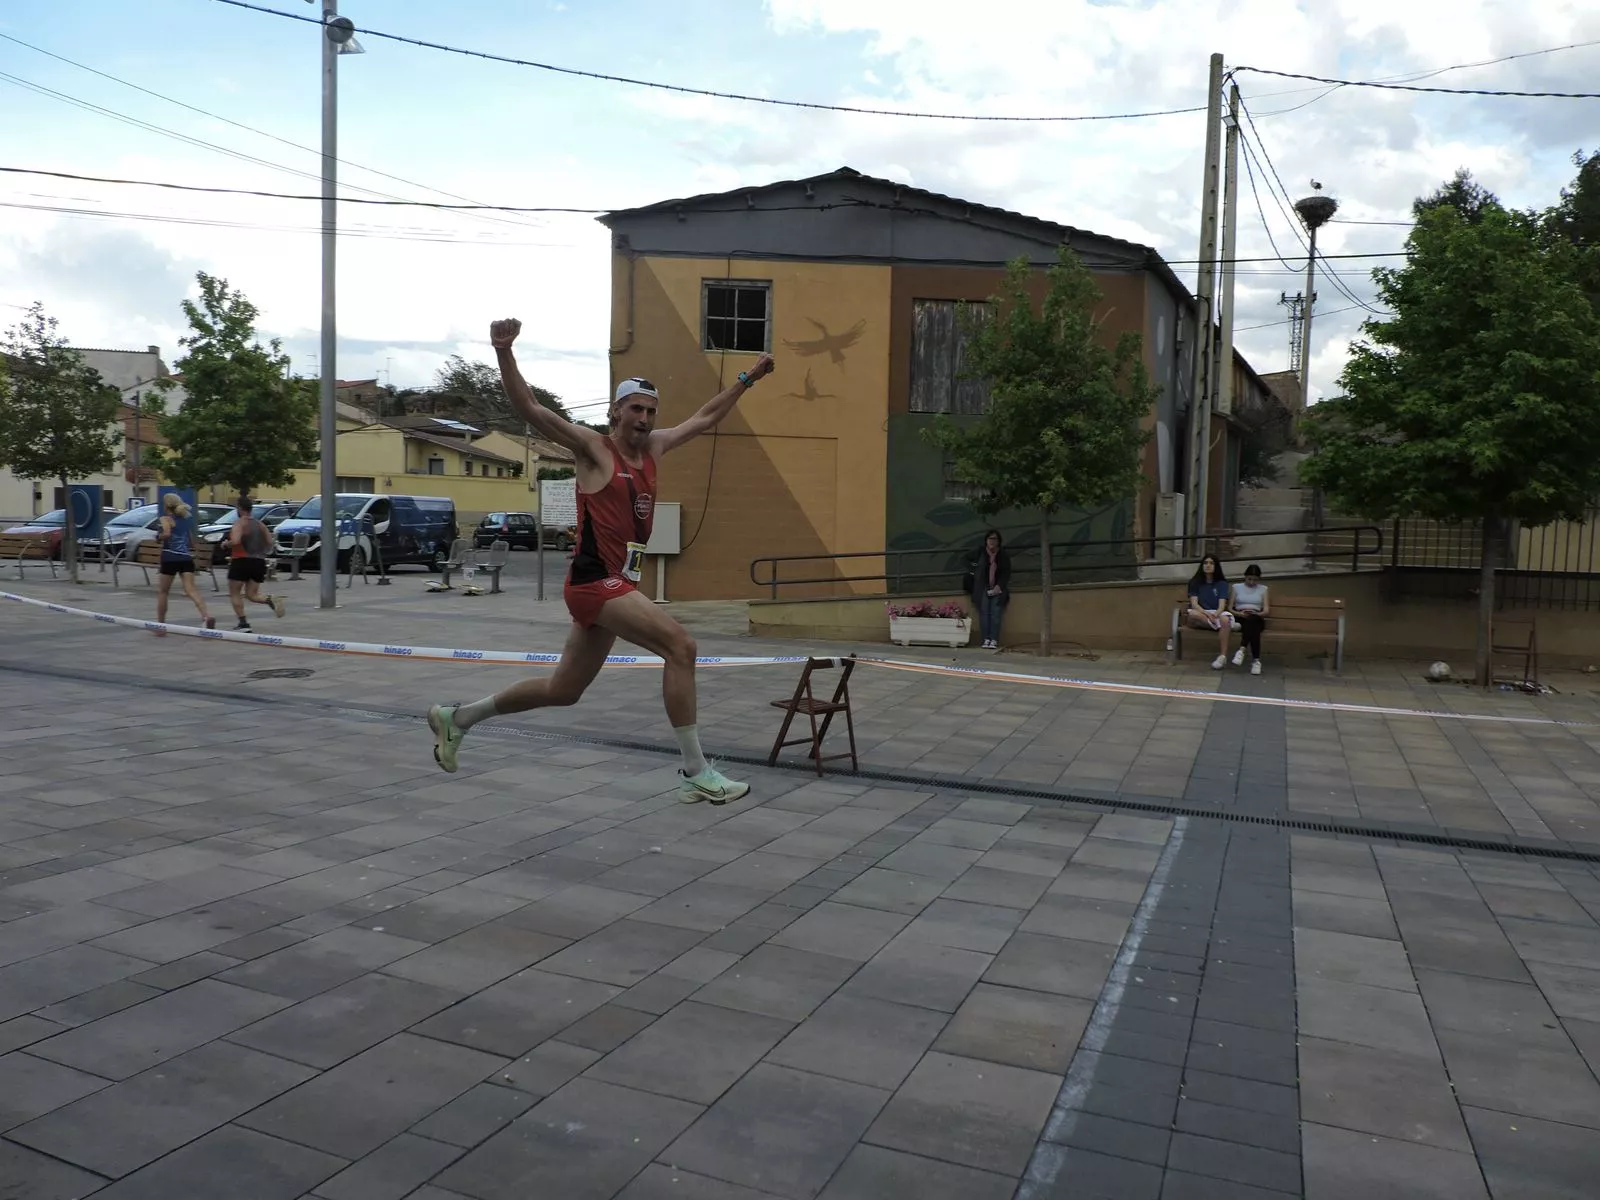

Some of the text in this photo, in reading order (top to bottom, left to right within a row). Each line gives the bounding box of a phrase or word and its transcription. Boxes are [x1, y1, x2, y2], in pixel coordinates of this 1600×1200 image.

[131, 499, 142, 509] P
[318, 641, 346, 651] hinaco
[383, 645, 412, 655] hinaco
[453, 649, 483, 659] hinaco
[525, 653, 557, 662] hinaco
